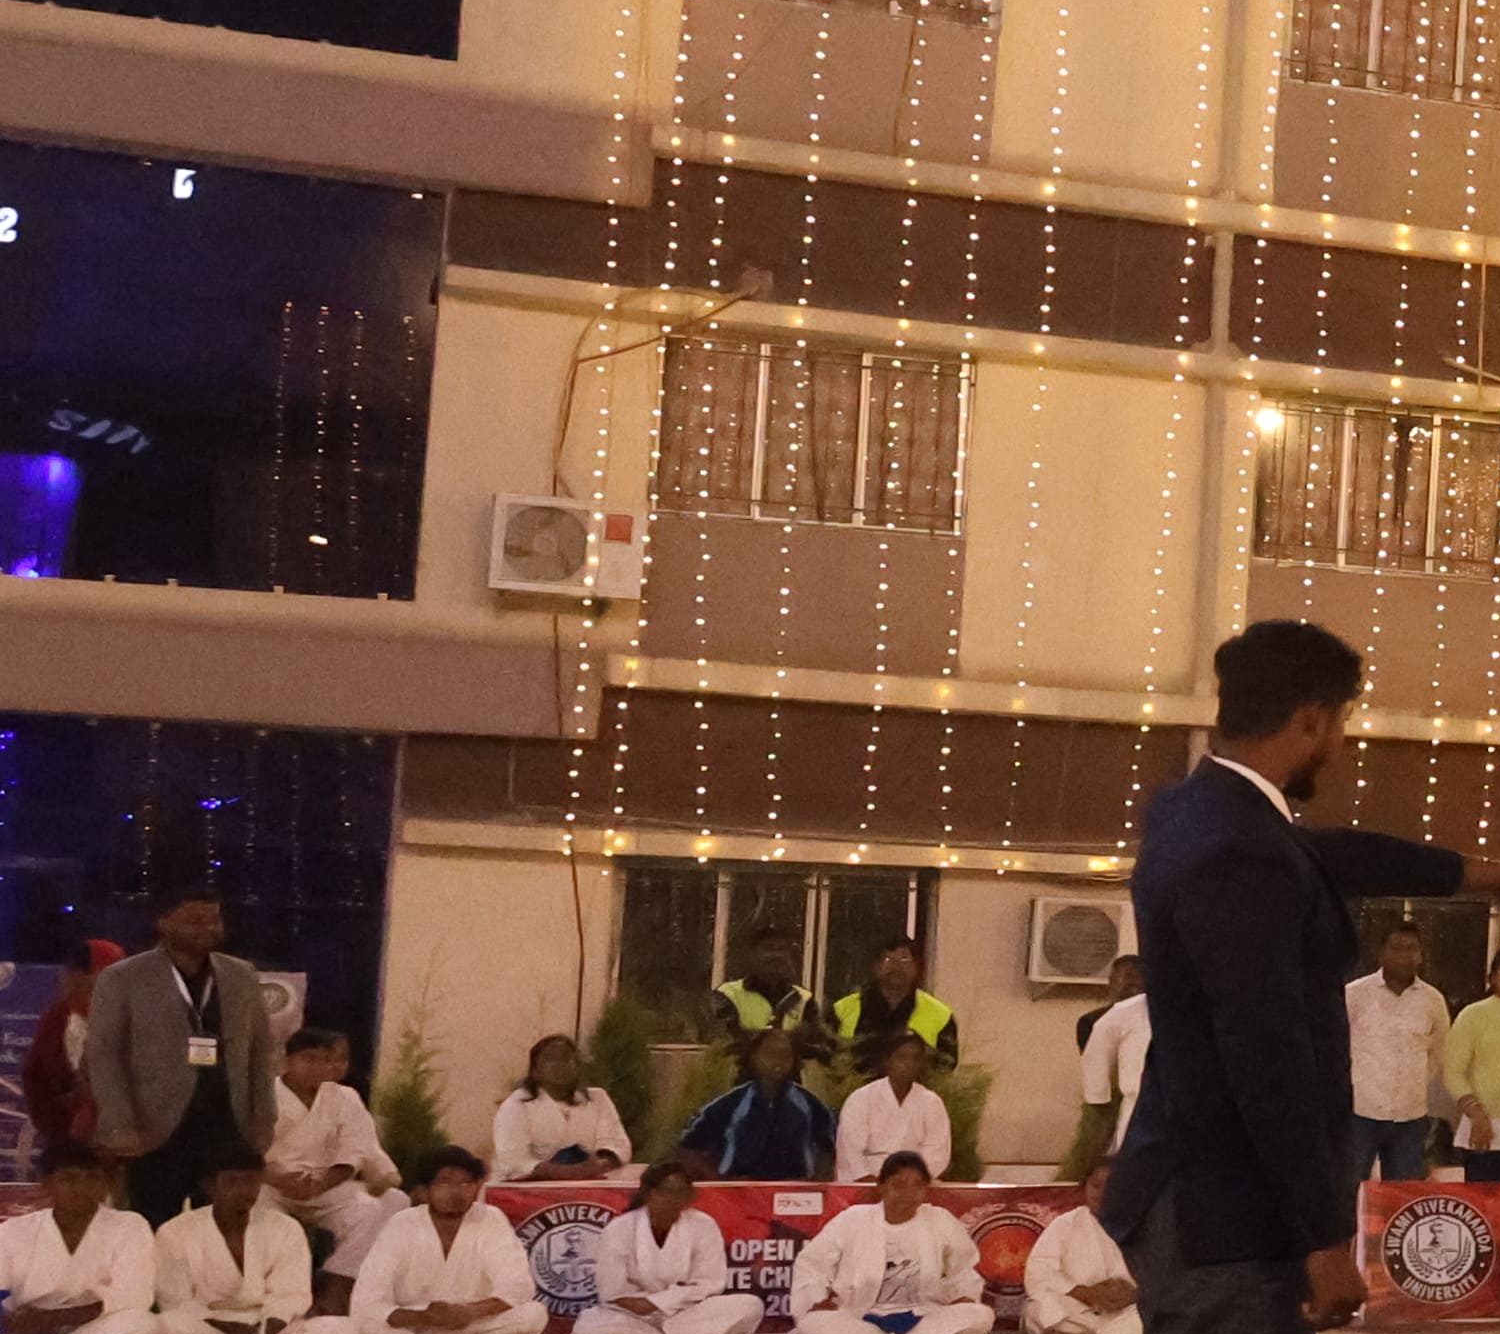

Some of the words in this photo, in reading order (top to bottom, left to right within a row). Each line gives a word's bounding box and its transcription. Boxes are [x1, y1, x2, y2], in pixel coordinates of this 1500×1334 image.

[545, 1205, 611, 1225] VIVEKA
[1386, 1211, 1415, 1256] SWAMI
[1413, 1199, 1493, 1253] VIVEKANANDA
[730, 1239, 794, 1262] OPEN
[1402, 1274, 1478, 1301] UNIVERSITY
